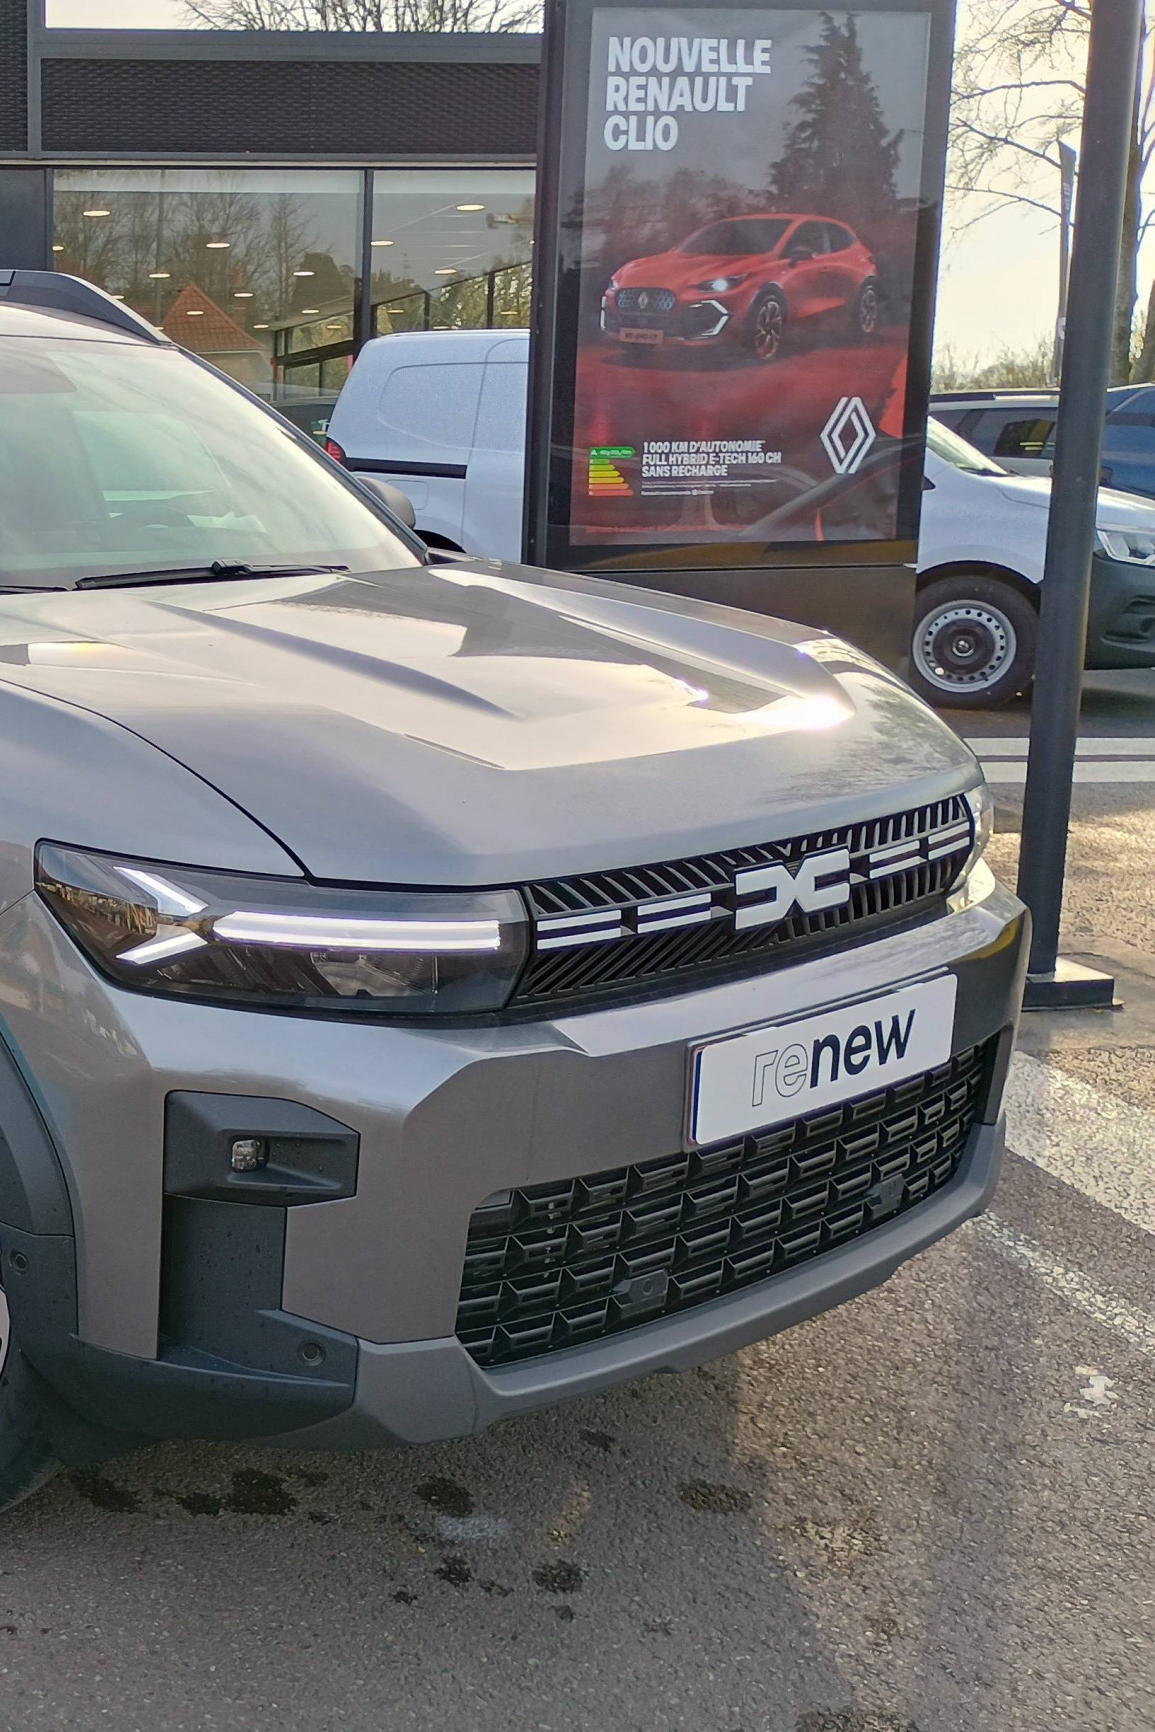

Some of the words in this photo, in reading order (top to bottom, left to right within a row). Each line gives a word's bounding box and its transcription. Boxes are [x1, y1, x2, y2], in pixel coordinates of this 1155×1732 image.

[607, 36, 772, 74] NOUVELLE
[605, 76, 753, 112] RENAULT
[603, 114, 678, 151] CLIO
[642, 454, 667, 465] FULL
[668, 453, 707, 465] HYBRID
[709, 452, 746, 464] E-TECH
[766, 452, 782, 464] CH
[642, 466, 671, 477] SANS
[671, 465, 728, 477] RECHARGE
[752, 1008, 916, 1108] renew
